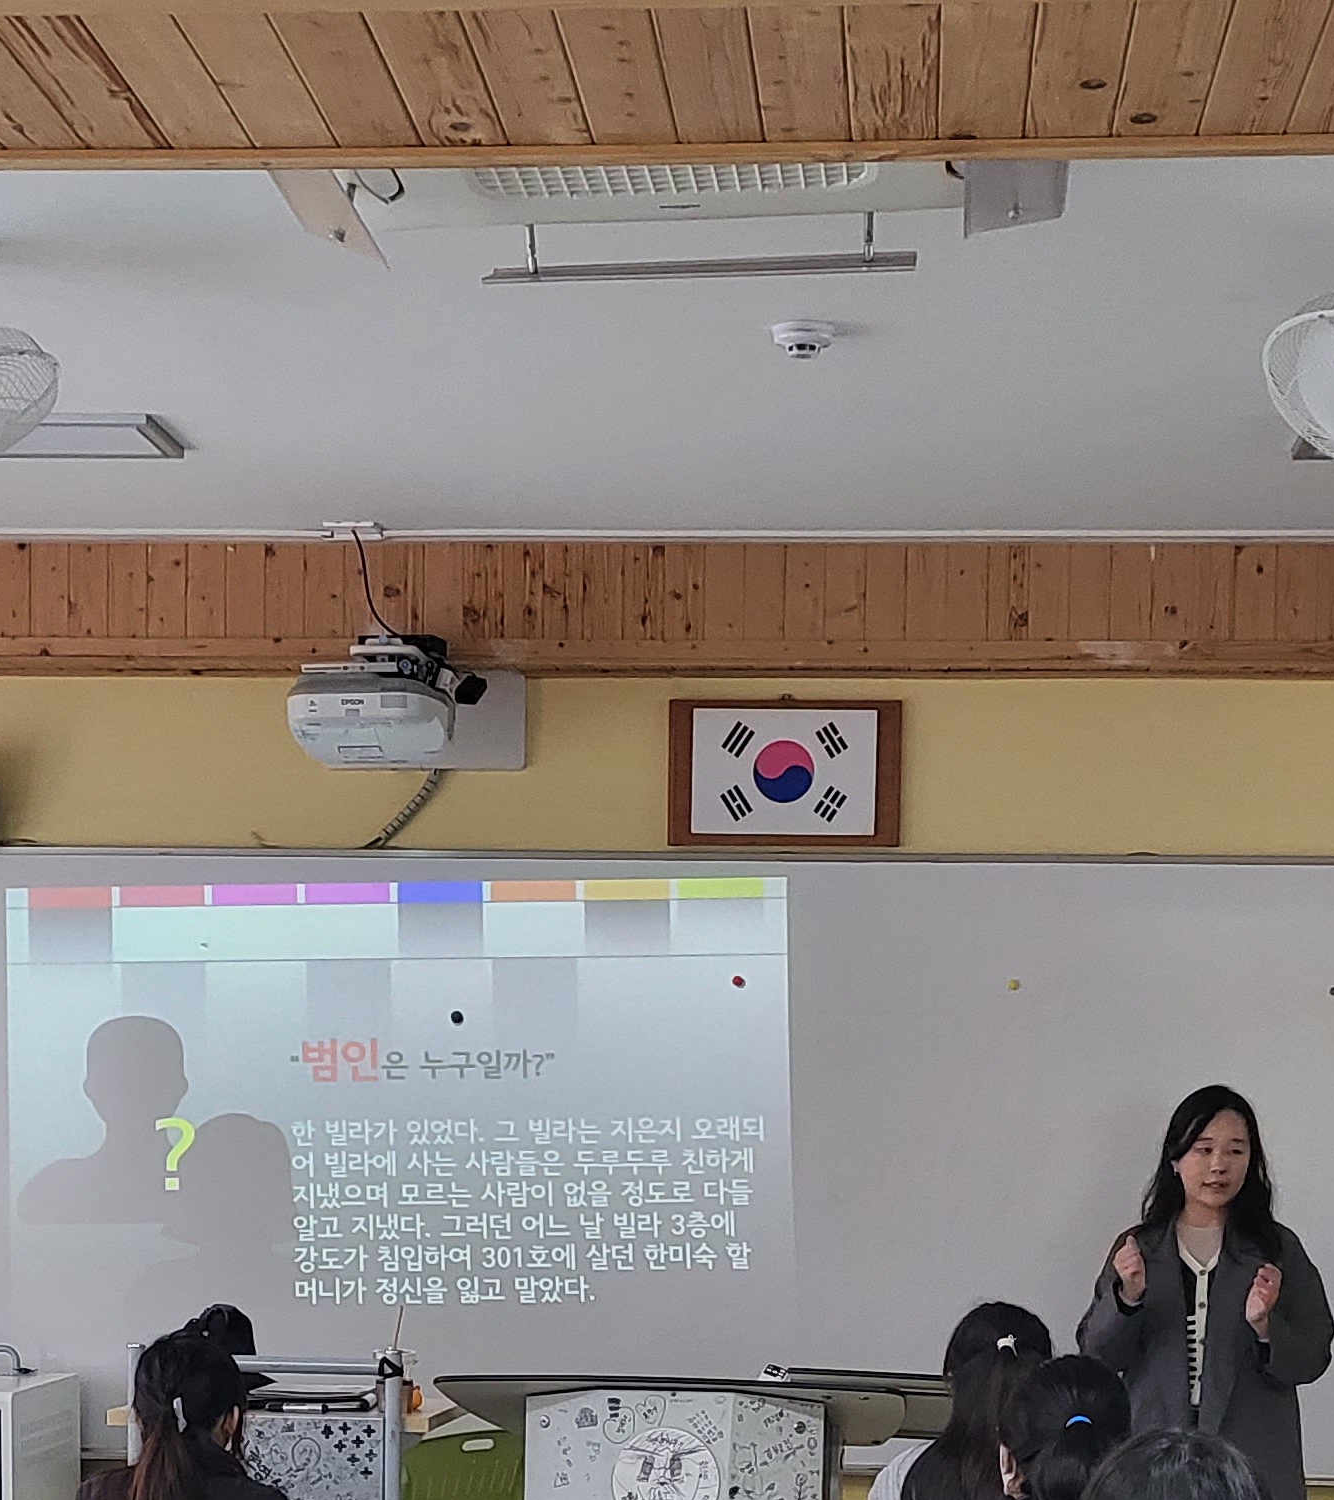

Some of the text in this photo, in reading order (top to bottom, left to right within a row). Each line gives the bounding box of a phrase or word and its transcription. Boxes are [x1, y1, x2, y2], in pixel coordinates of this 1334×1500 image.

[340, 698, 366, 706] EPSON
[291, 1115, 765, 1147] 한 빌라가 있었다. 그 빌라는 지은지 오래되
[291, 1146, 755, 1179] 어 빌라에 사는 사람들은 두루두루 친하게
[292, 1178, 754, 1210] 지냈으며 모르는 사람이 없을 정도로 다들
[293, 1209, 736, 1242] 알고 지냈다. 그러던 어느 날 빌라 3층에
[293, 1240, 752, 1274] 강도가 침입하여 301호에 살던 한미숙 할
[293, 1274, 597, 1306] 머니가 정신을 잃고 말았다.
